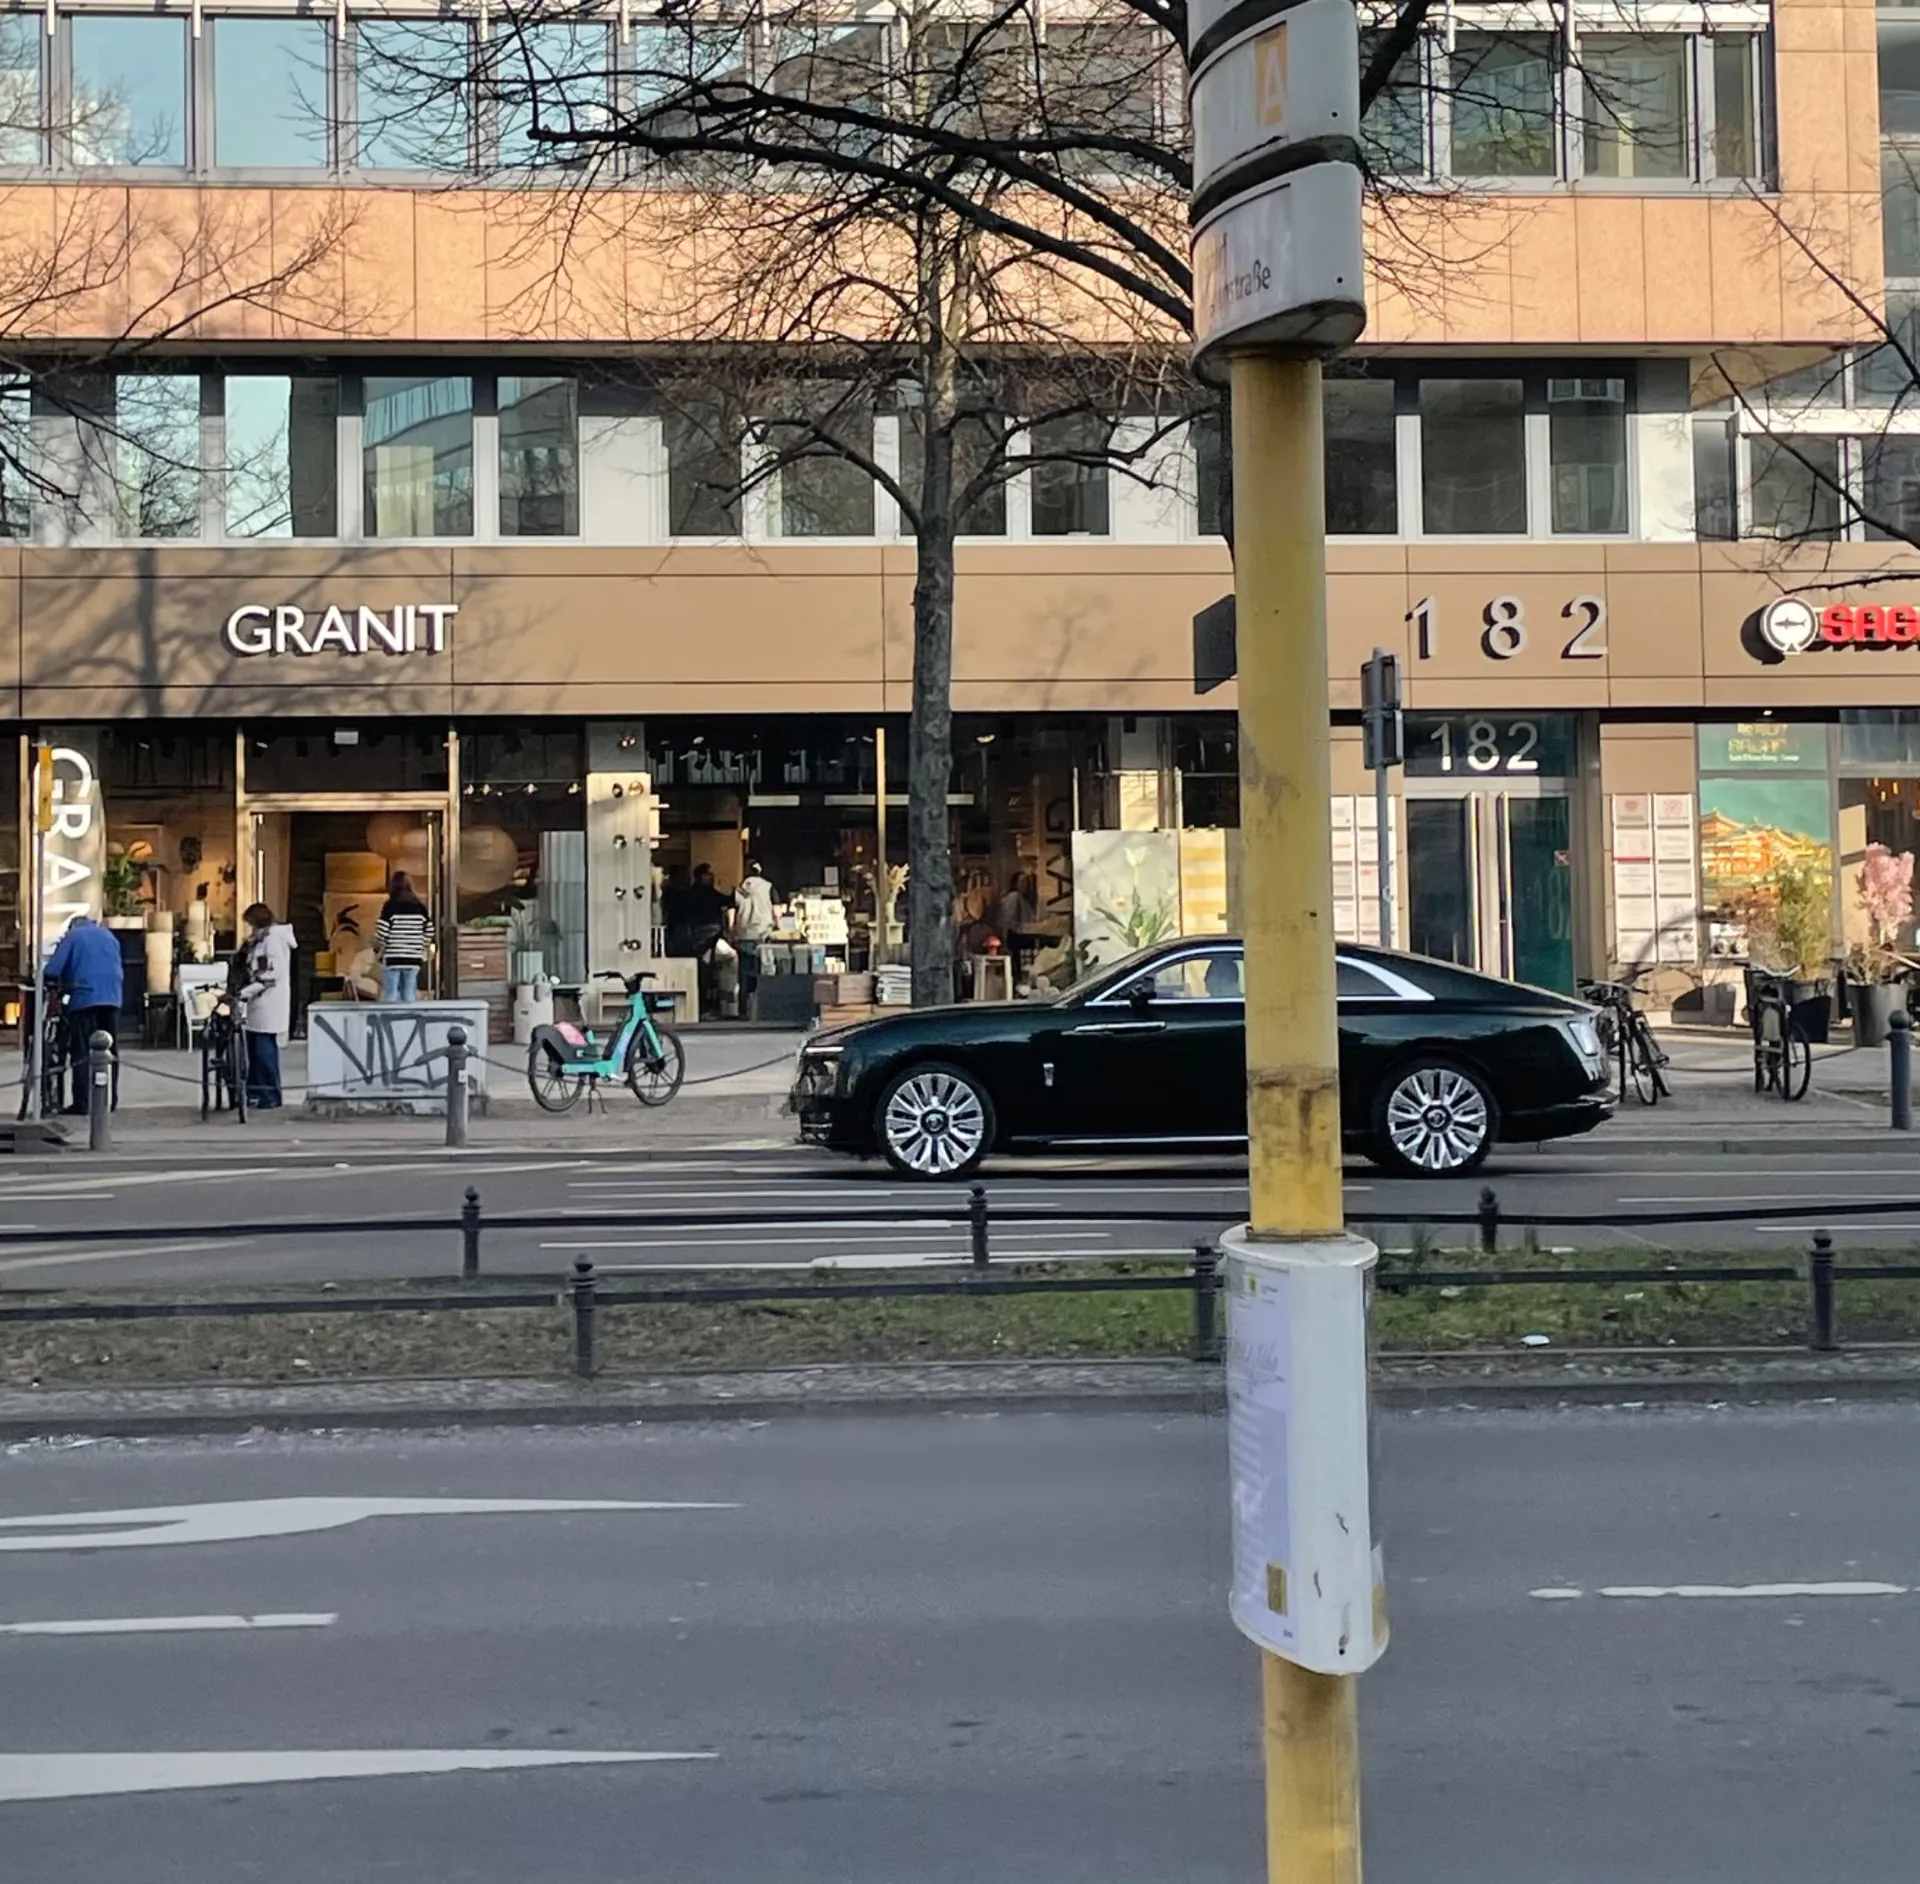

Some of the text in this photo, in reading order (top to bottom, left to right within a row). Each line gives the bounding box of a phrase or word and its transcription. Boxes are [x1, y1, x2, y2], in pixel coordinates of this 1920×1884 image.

[227, 604, 459, 653] GRANIT
[1410, 594, 1608, 657] 182
[1821, 604, 1920, 642] SAG
[1430, 721, 1539, 771] 182
